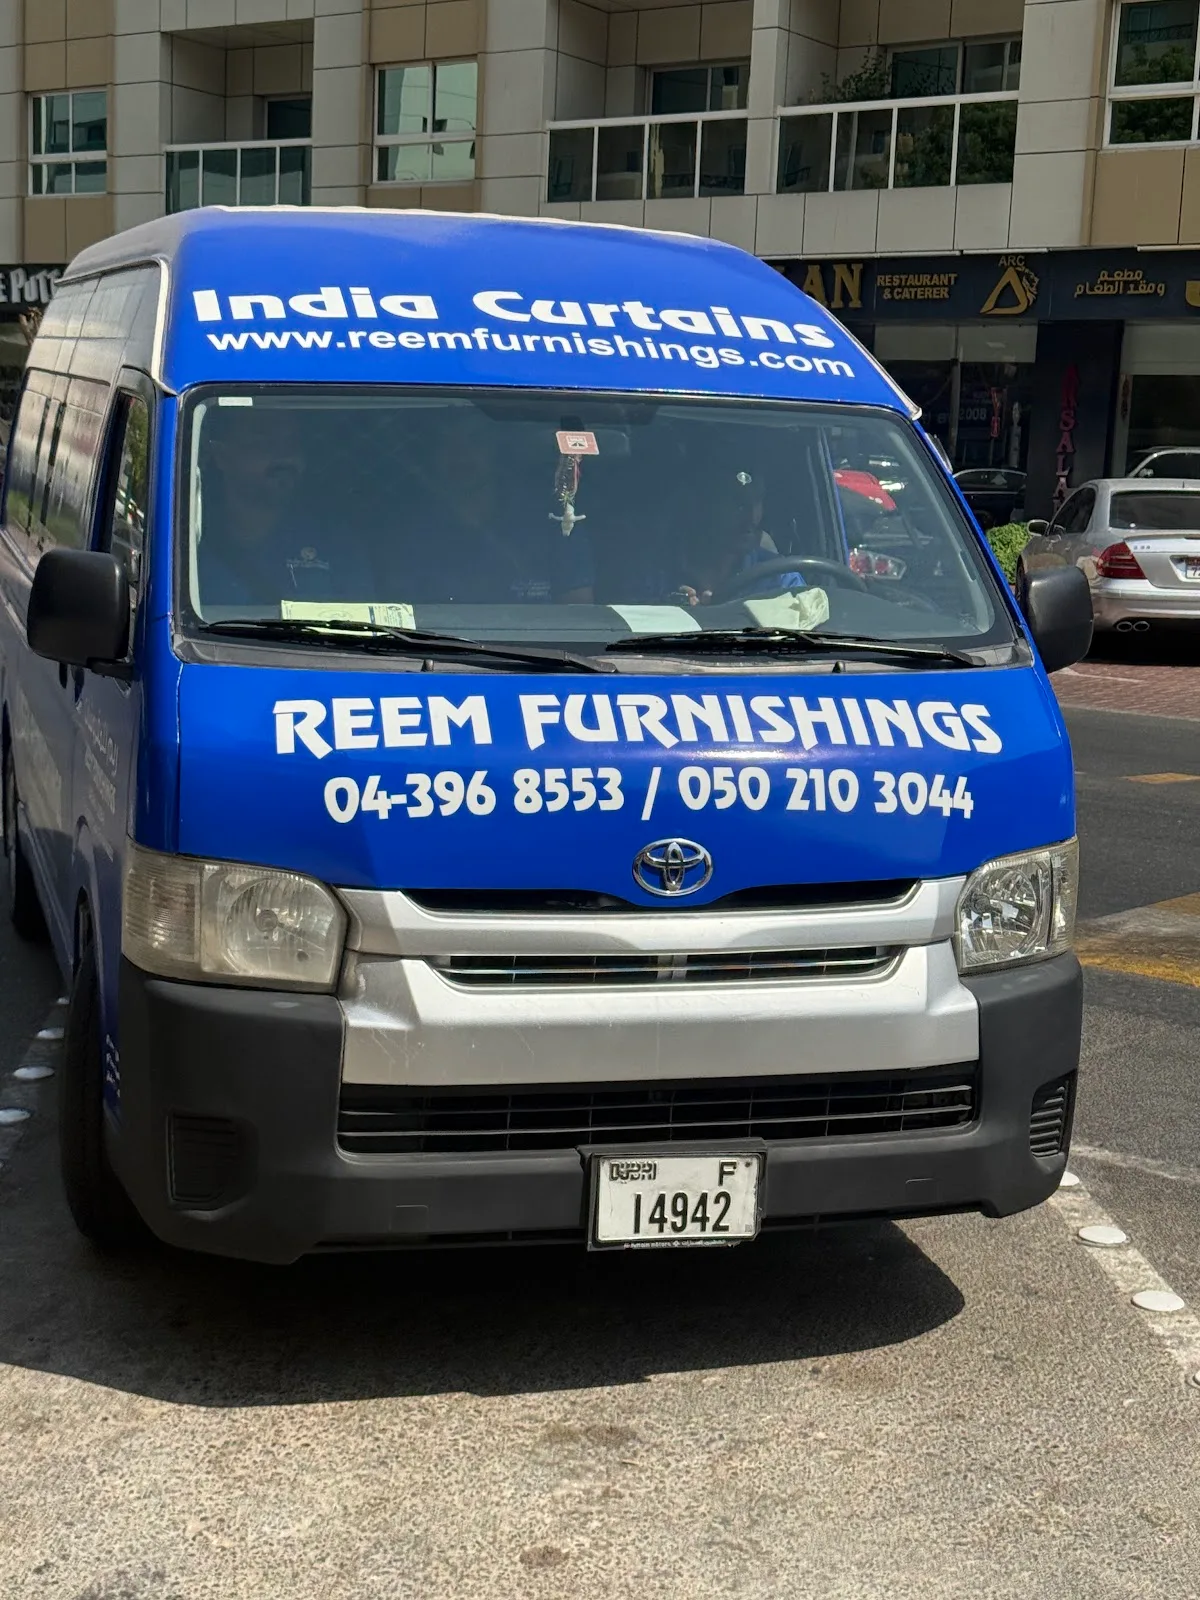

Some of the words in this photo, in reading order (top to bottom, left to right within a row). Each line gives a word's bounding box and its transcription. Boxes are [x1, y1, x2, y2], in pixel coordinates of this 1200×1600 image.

[876, 273, 958, 287] RESTAURANT
[998, 255, 1025, 267] ARC
[1097, 268, 1144, 284] مطعم
[776, 263, 864, 309] AN
[882, 287, 893, 300] &
[893, 287, 950, 300] CATERER
[193, 286, 439, 322] India
[472, 290, 835, 350] Curtains
[206, 327, 856, 379] www.reemfurnishings.com
[273, 694, 493, 759] REEM
[518, 693, 1003, 755] FURNISHINGS
[324, 769, 498, 824] 04-396
[513, 767, 625, 814] 8553
[641, 766, 662, 822] /
[678, 766, 771, 812] 050
[785, 766, 859, 813] 210
[873, 769, 974, 820] 3044
[717, 1159, 738, 1187] F
[633, 1190, 732, 1235] 14942
